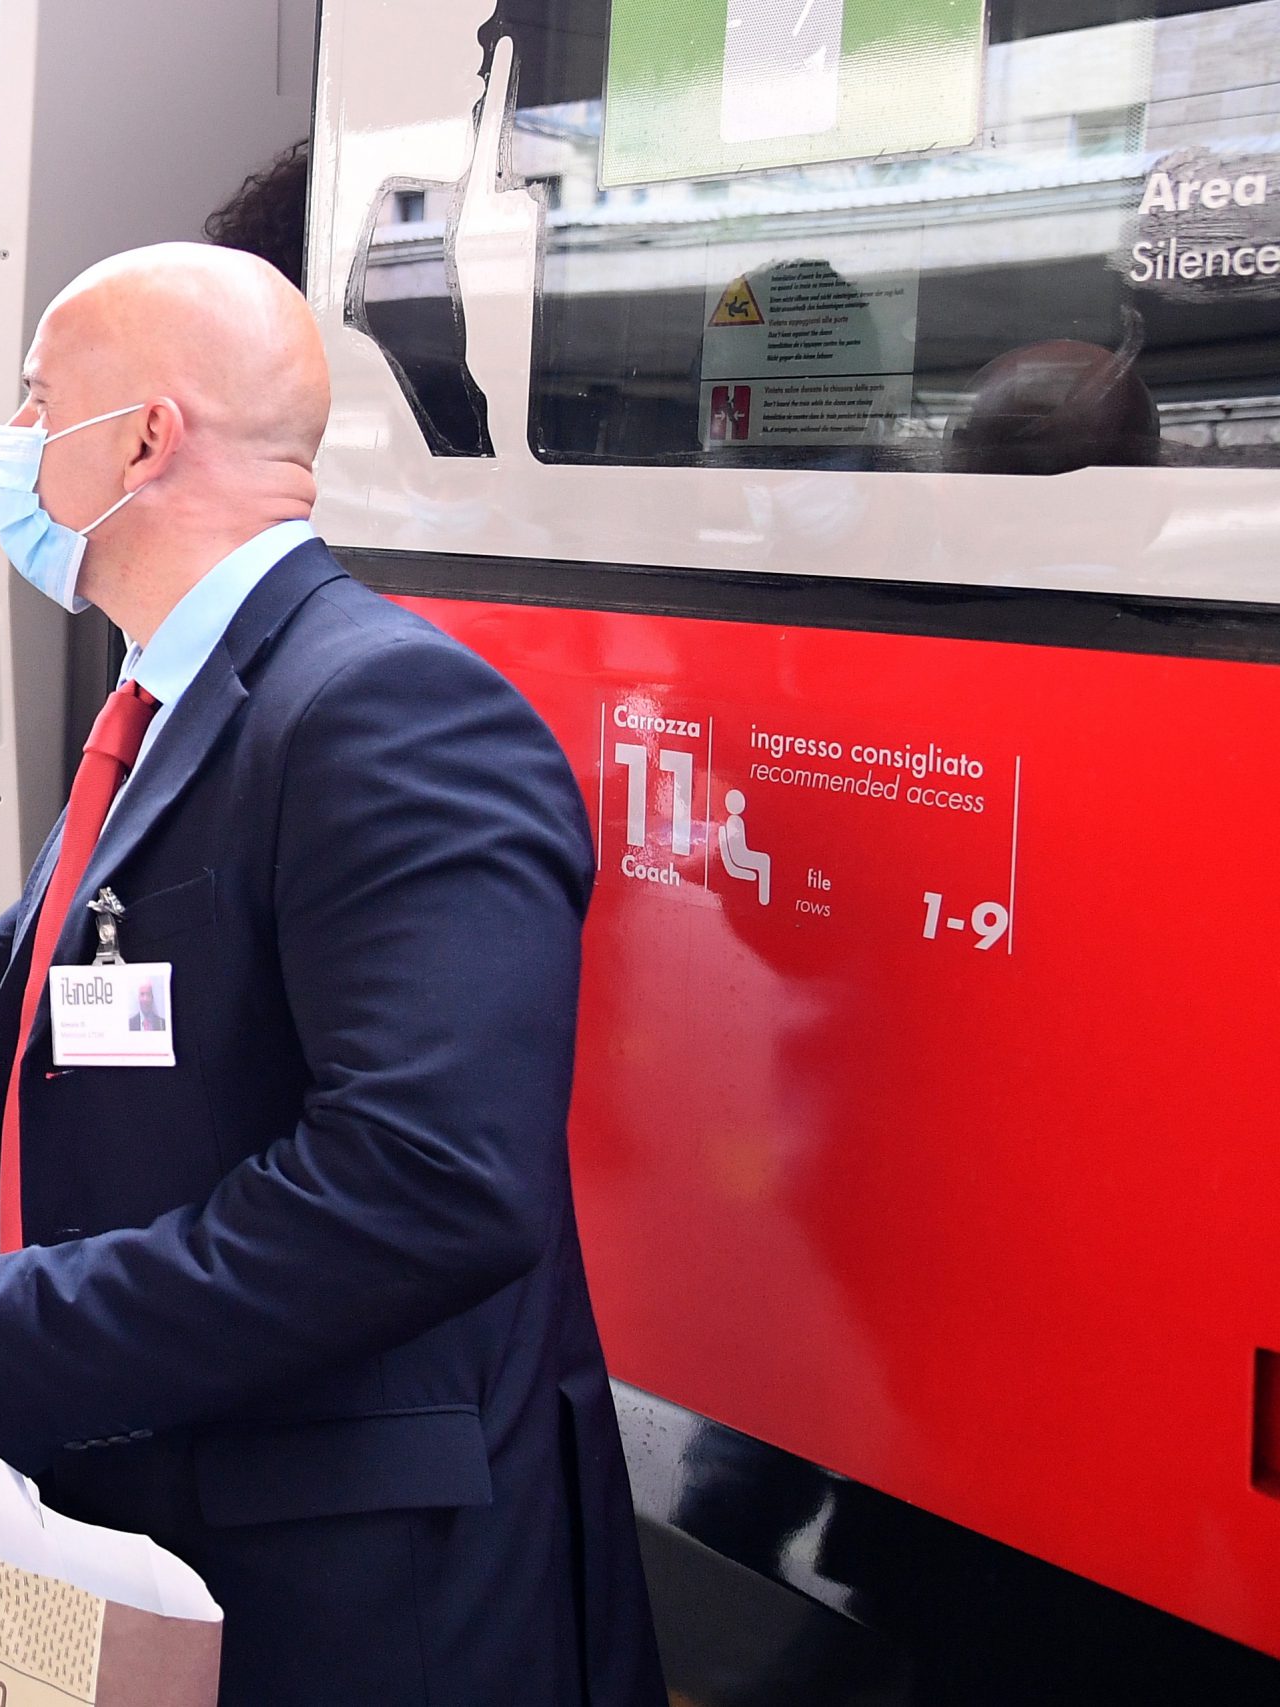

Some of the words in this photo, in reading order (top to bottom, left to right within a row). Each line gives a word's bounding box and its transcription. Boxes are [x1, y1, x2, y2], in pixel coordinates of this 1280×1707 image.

[1138, 172, 1267, 215] Area
[1129, 237, 1280, 282] Silence
[613, 705, 701, 737] Carrozza
[750, 724, 843, 759] ingresso
[850, 743, 984, 779] consigliato
[615, 743, 693, 856] 11
[750, 763, 900, 800] recommended
[906, 786, 985, 813] access
[621, 855, 680, 886] Coach
[807, 868, 831, 891] file
[795, 899, 831, 917] rows
[922, 891, 1008, 950] 1-9
